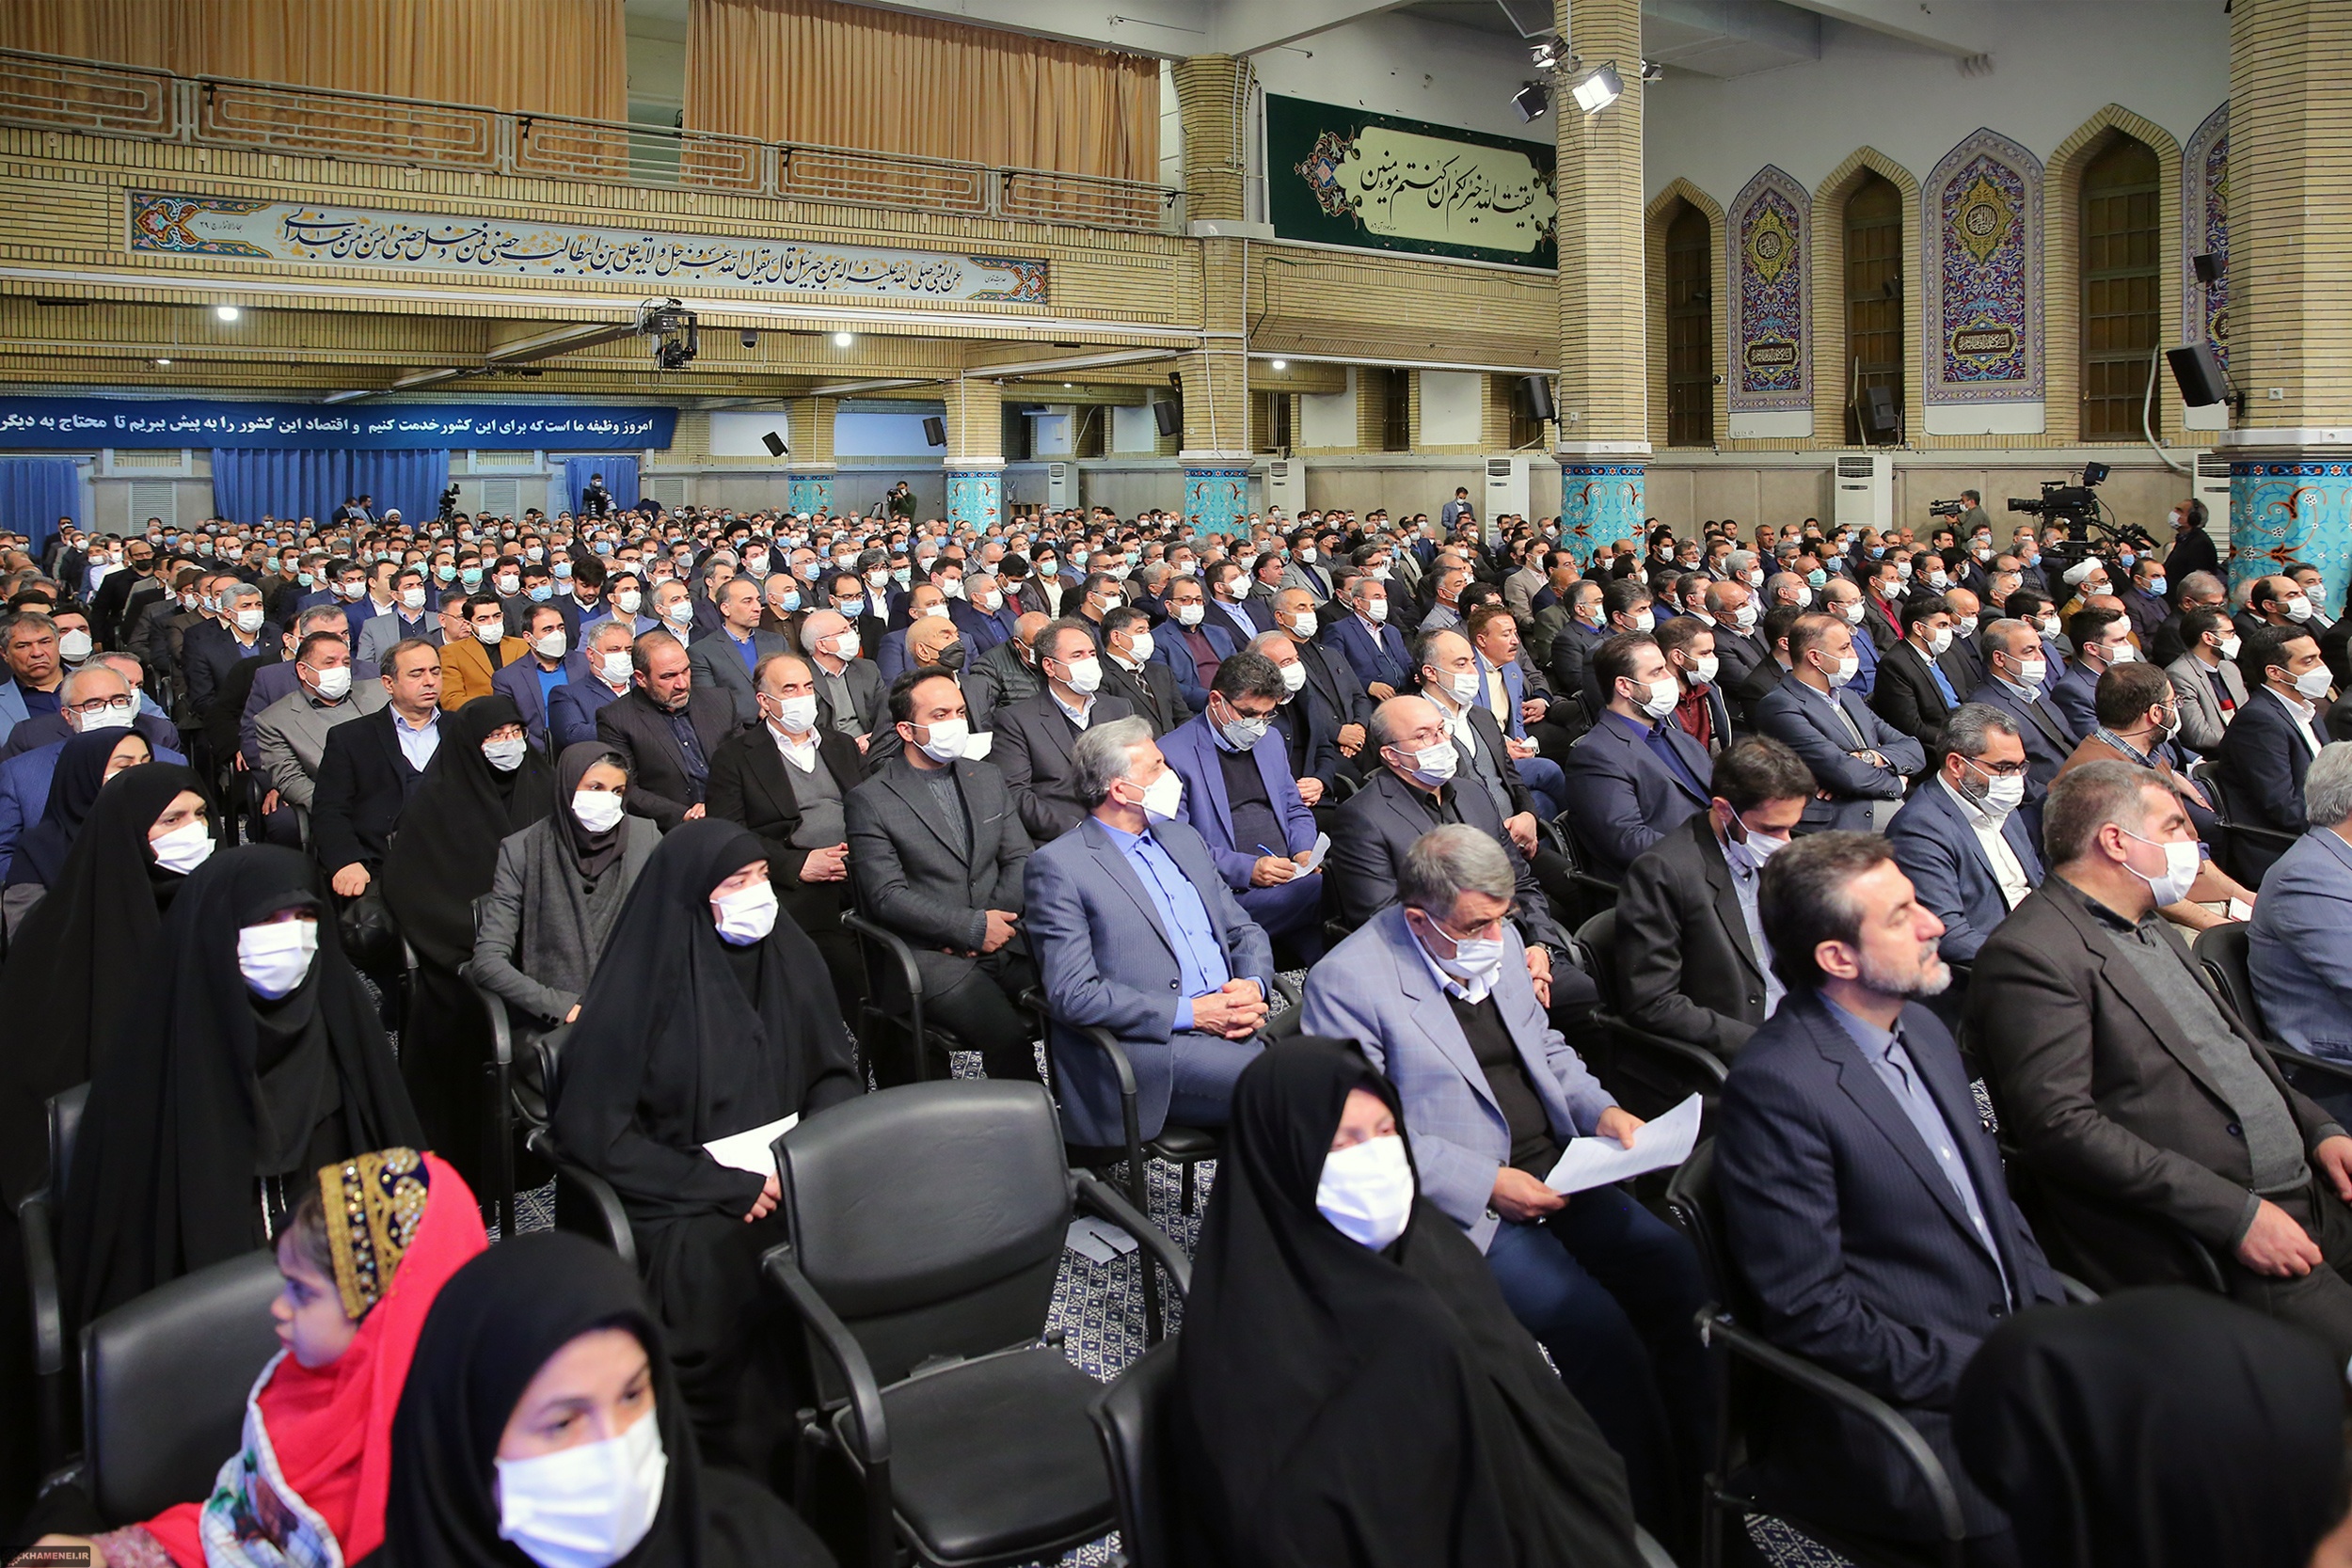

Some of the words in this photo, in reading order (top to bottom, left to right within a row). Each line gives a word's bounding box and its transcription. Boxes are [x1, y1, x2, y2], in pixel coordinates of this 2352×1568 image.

[1390, 155, 1460, 225] کنتم
[1456, 173, 1482, 224] خیر
[1473, 180, 1497, 209] الله
[1446, 165, 1478, 233] لکم
[39, 414, 56, 433] به
[58, 413, 108, 433] محتاج
[113, 414, 127, 430] تا
[129, 417, 167, 434] ببریم
[168, 414, 201, 434] پیش
[202, 417, 218, 433] به
[220, 415, 235, 433] را
[238, 416, 276, 434] کشور
[278, 417, 302, 435] این
[305, 417, 349, 432] اقتصاد
[351, 422, 360, 435] و
[368, 418, 396, 435] کنیم
[398, 418, 440, 432] خدمت
[439, 418, 473, 436] کشور
[474, 418, 497, 436] این
[499, 419, 527, 435] برای
[529, 419, 545, 433] که
[545, 419, 570, 432] است
[573, 419, 585, 432] ما
[586, 419, 620, 435] وظیفه
[621, 419, 653, 436] امروز
